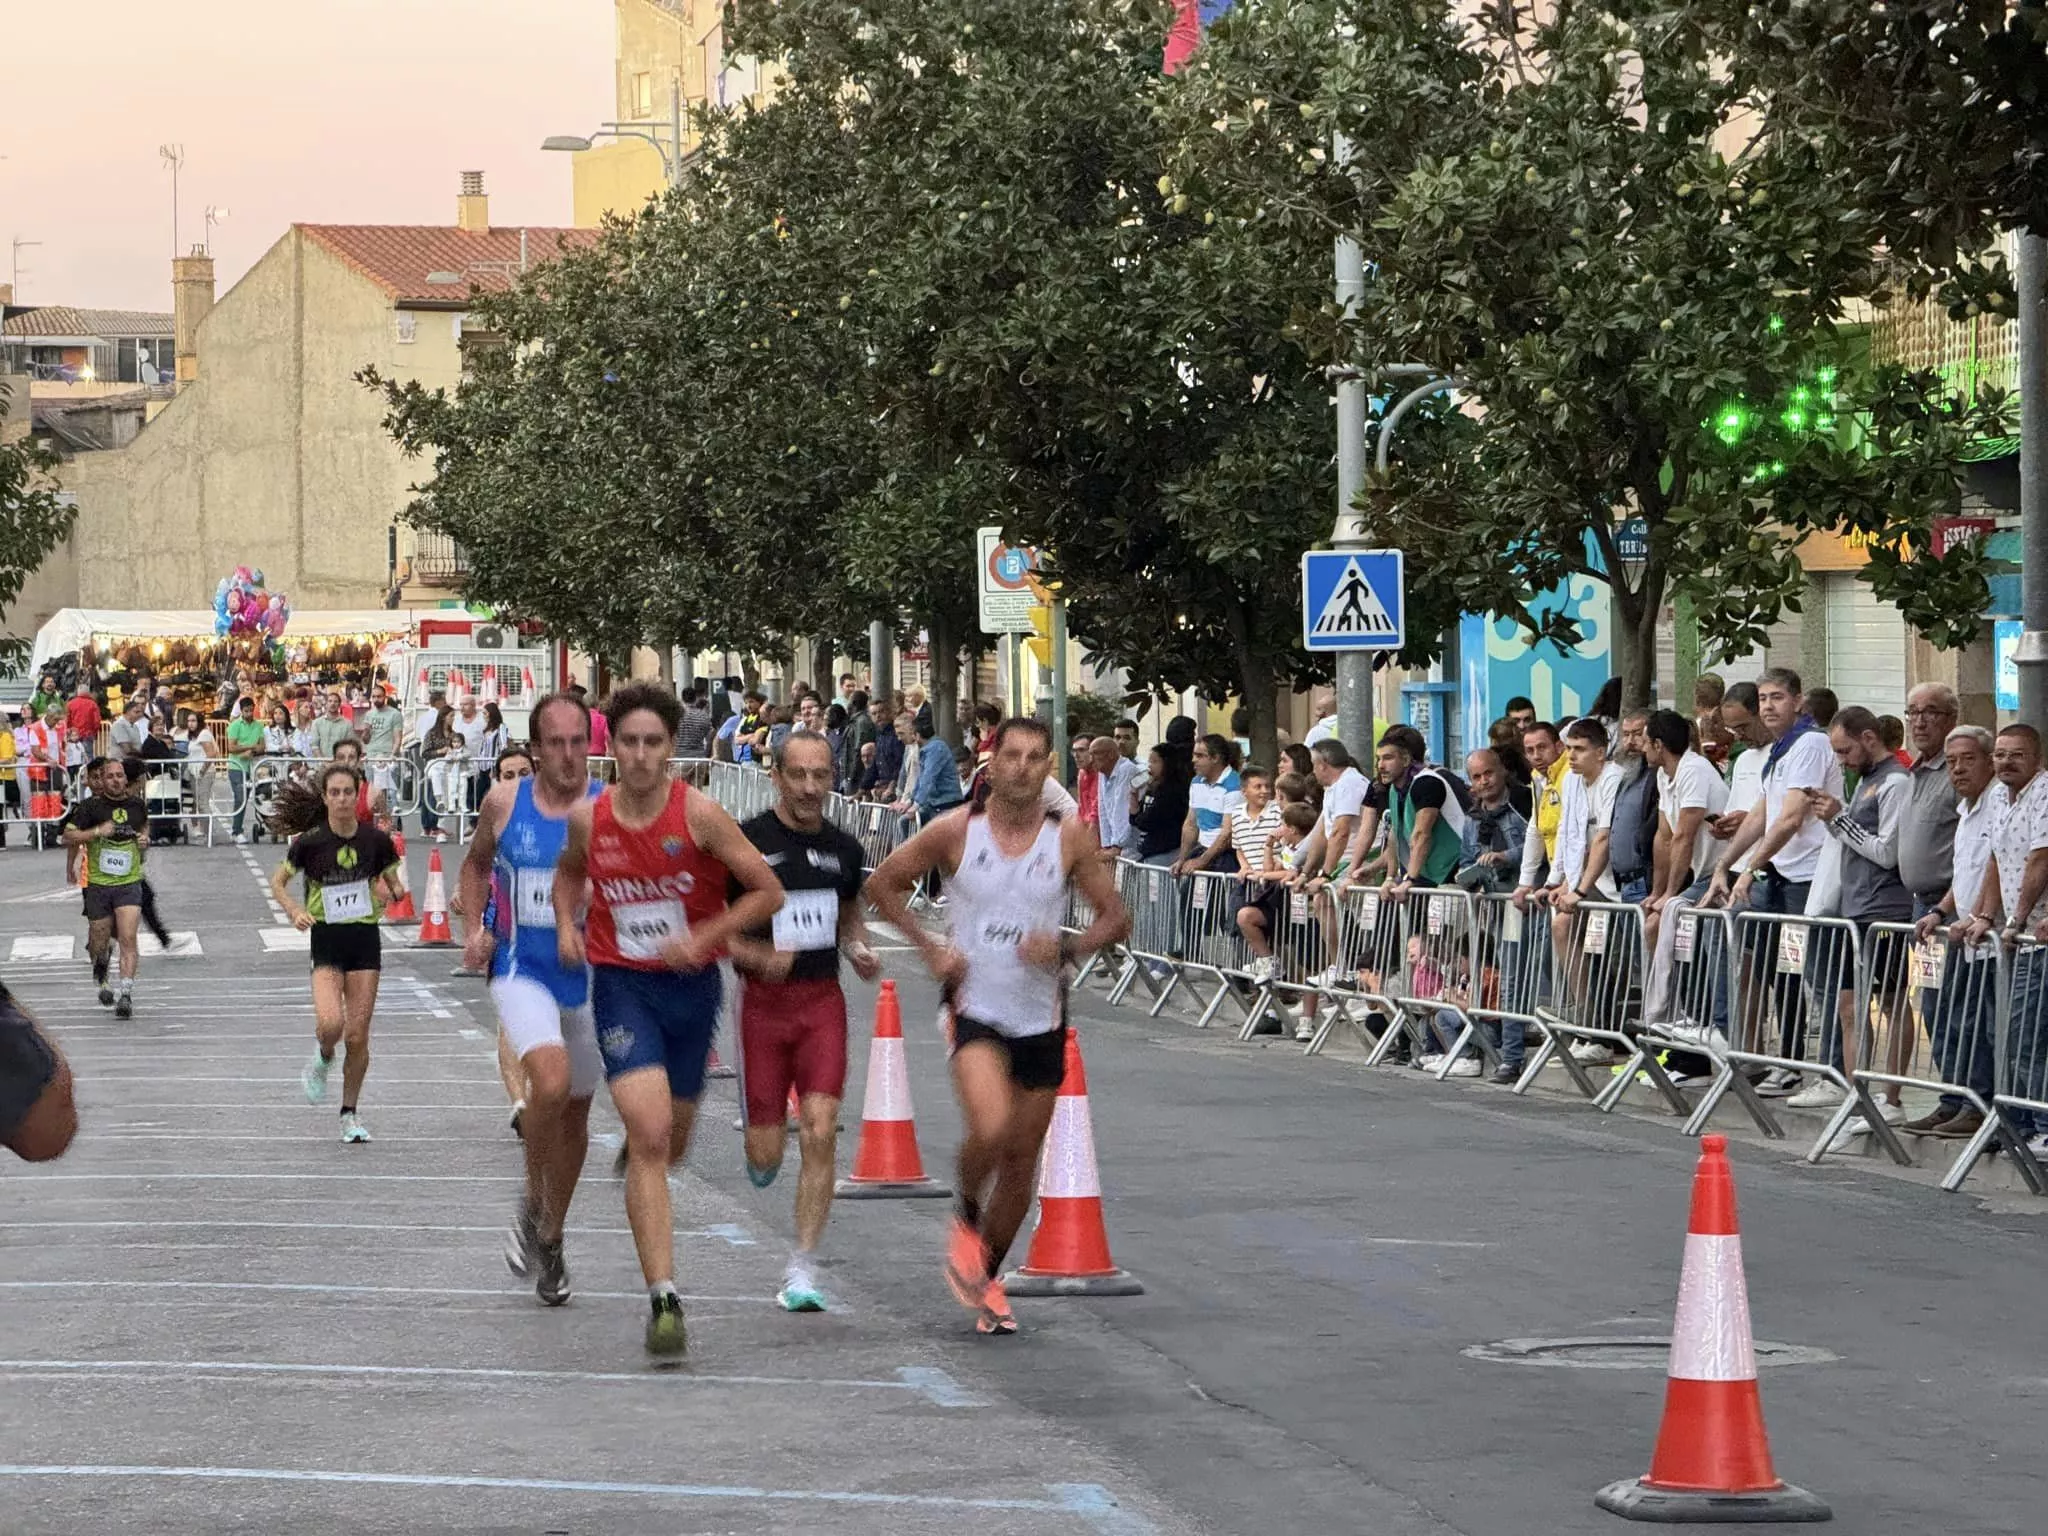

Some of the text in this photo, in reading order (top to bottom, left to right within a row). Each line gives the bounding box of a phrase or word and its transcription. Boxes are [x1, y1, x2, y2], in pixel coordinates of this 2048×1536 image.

[1631, 524, 1648, 535] Call
[713, 680, 722, 694] P
[334, 893, 358, 908] 177
